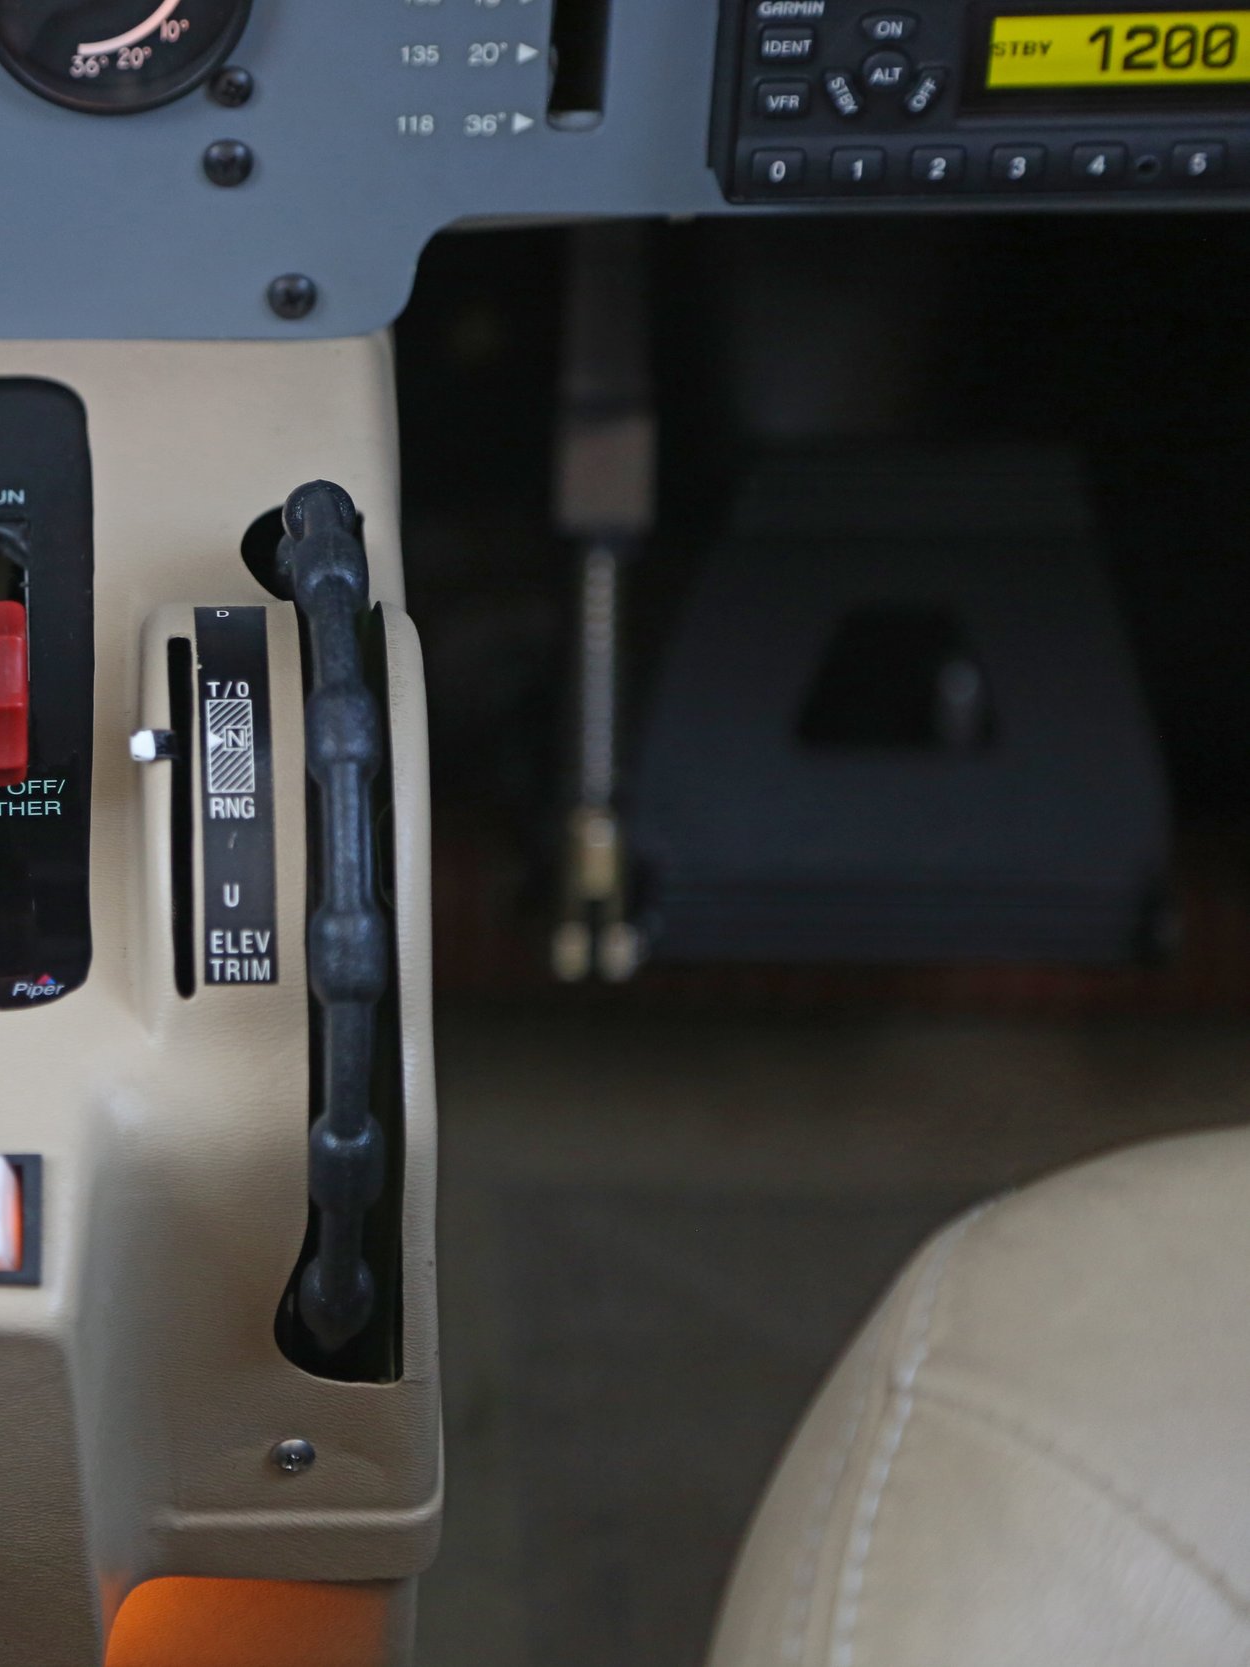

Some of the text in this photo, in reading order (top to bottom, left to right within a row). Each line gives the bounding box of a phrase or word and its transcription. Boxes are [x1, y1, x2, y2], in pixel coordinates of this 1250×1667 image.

[758, 1, 825, 17] GARMIN
[876, 21, 903, 38] ON
[401, 45, 440, 66] 135
[763, 39, 812, 55] IDENT
[993, 23, 1239, 72] STBY 1200
[869, 67, 902, 84] ALT
[768, 95, 800, 112] VFR
[829, 77, 858, 115] STBY
[911, 77, 937, 112] OFF
[398, 114, 435, 136] 118
[768, 160, 786, 183] 0
[850, 159, 863, 181] 1
[928, 157, 947, 180] 2
[1007, 156, 1027, 179] 3
[1087, 154, 1106, 175] 4
[216, 610, 230, 618] D
[227, 730, 244, 748] N
[209, 797, 255, 819] RNG
[223, 883, 239, 907] U
[210, 930, 270, 954] ELEV
[210, 959, 270, 981] TRIM
[12, 982, 65, 999] Piper
